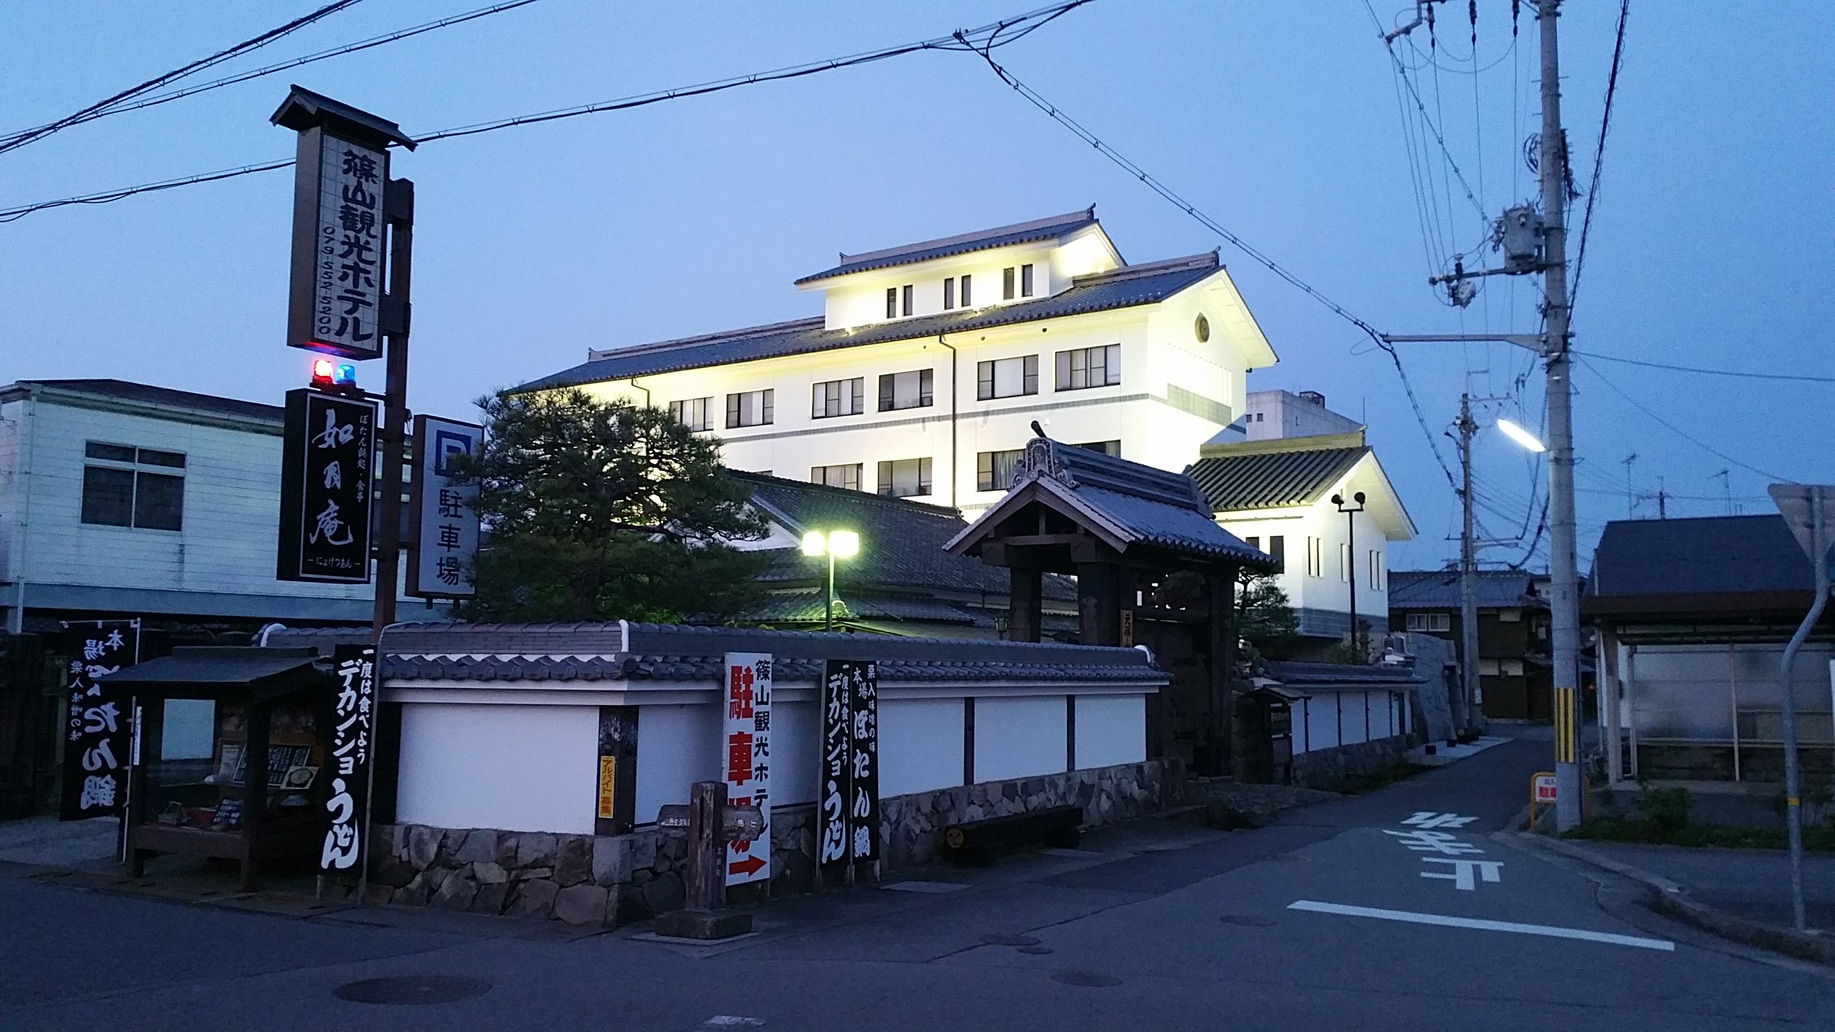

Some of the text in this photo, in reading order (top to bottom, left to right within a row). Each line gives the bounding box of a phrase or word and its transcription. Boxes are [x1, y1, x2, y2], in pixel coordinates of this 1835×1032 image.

[318, 227, 335, 335] 079-552-5200
[334, 149, 379, 342] 篠山観光ホテル
[309, 407, 355, 546] 如月庵
[436, 489, 463, 586] 駐車場
[355, 648, 375, 765] 一度は食べよう
[840, 663, 851, 767] 一度は食べよう
